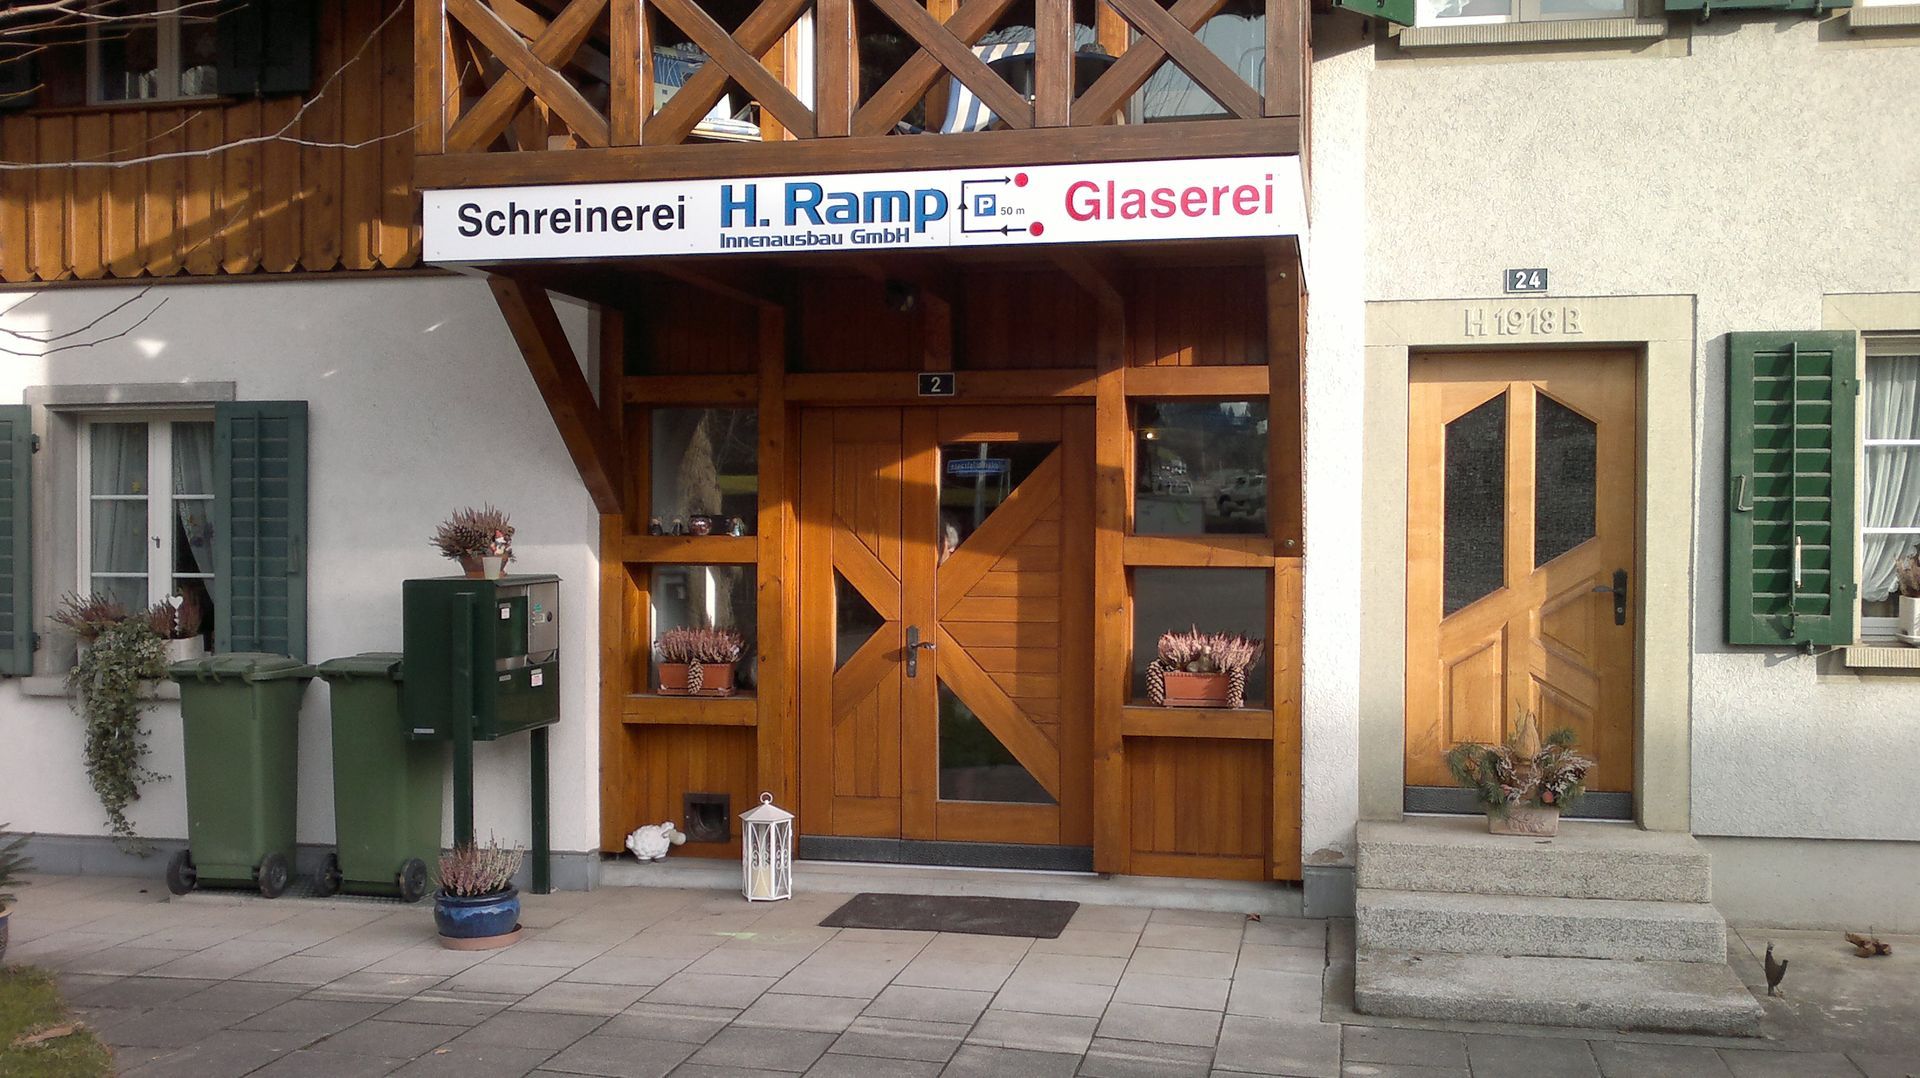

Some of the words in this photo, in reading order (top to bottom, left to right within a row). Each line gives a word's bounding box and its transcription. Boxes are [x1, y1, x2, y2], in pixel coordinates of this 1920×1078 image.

[720, 184, 771, 229] H.
[784, 181, 949, 233] Ramp
[978, 197, 994, 214] P
[1000, 206, 1013, 216] 50
[1015, 207, 1025, 215] m
[1064, 173, 1274, 222] Glaserei
[457, 195, 686, 237] Schreinerei
[720, 231, 843, 249] Innenausbau
[850, 227, 911, 245] GmbH
[1514, 270, 1541, 289] 24
[1494, 306, 1557, 336] 1918
[930, 376, 942, 392] 2
